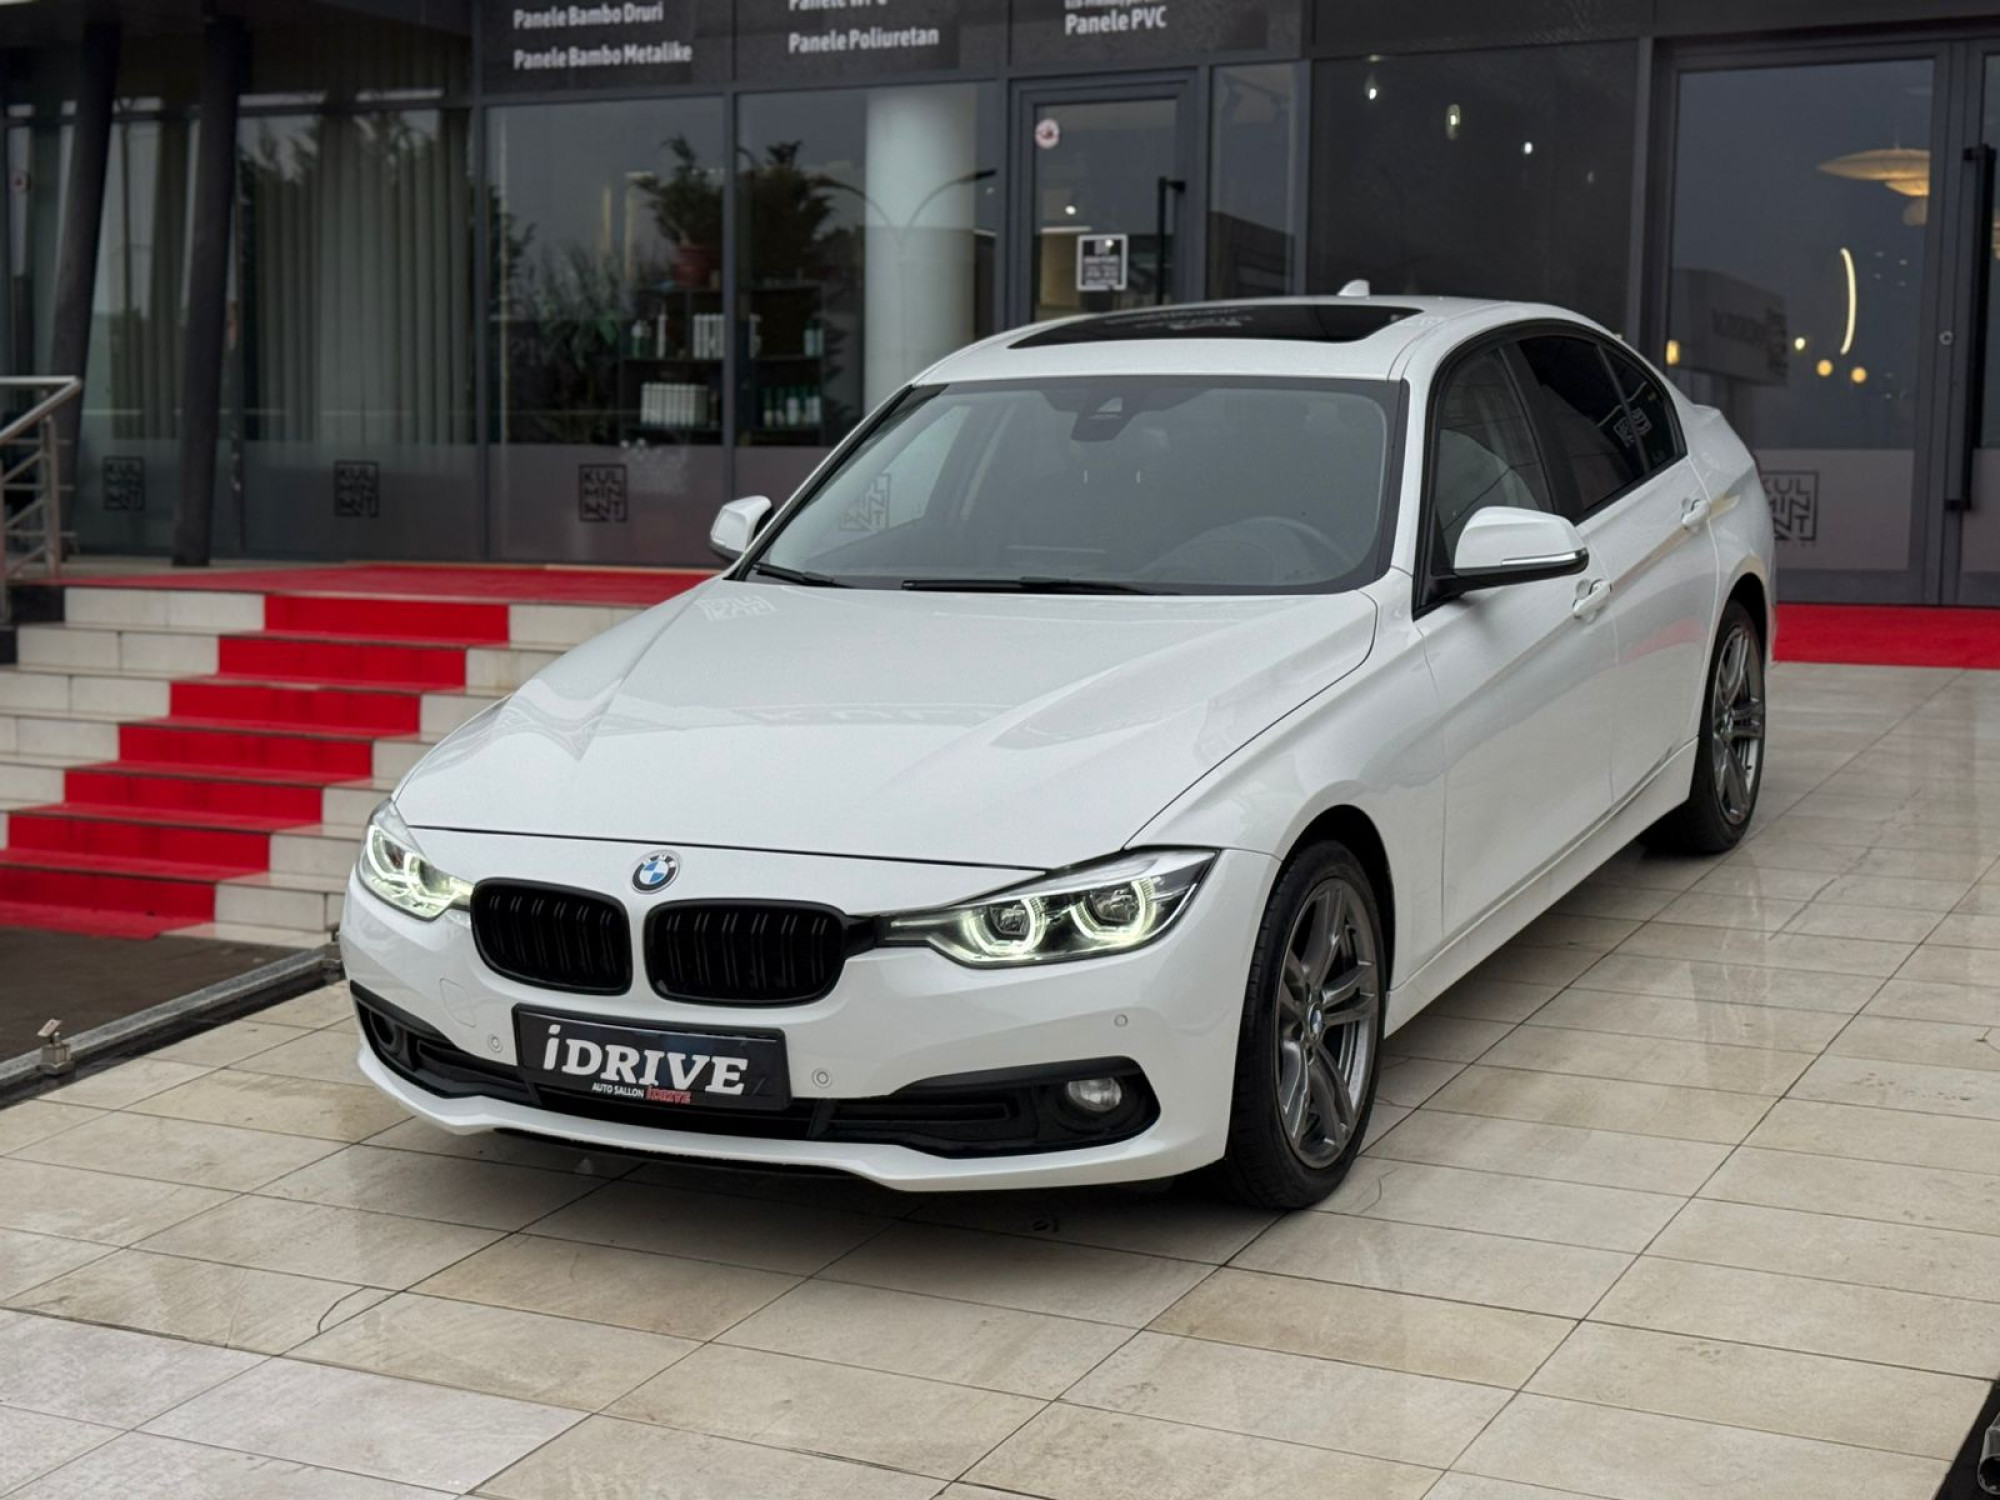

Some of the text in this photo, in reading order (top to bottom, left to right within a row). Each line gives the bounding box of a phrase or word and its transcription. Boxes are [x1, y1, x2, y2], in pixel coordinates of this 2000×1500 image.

[513, 1, 664, 30] Panele Bambo Druri
[1064, 5, 1168, 35] Panele PVC
[789, 26, 940, 53] Panele Poliuretan
[513, 40, 693, 70] Panele Bambo Metalike
[543, 1024, 749, 1095] iDRIVE
[591, 1082, 613, 1094] AUTO
[614, 1085, 645, 1099] SALLON
